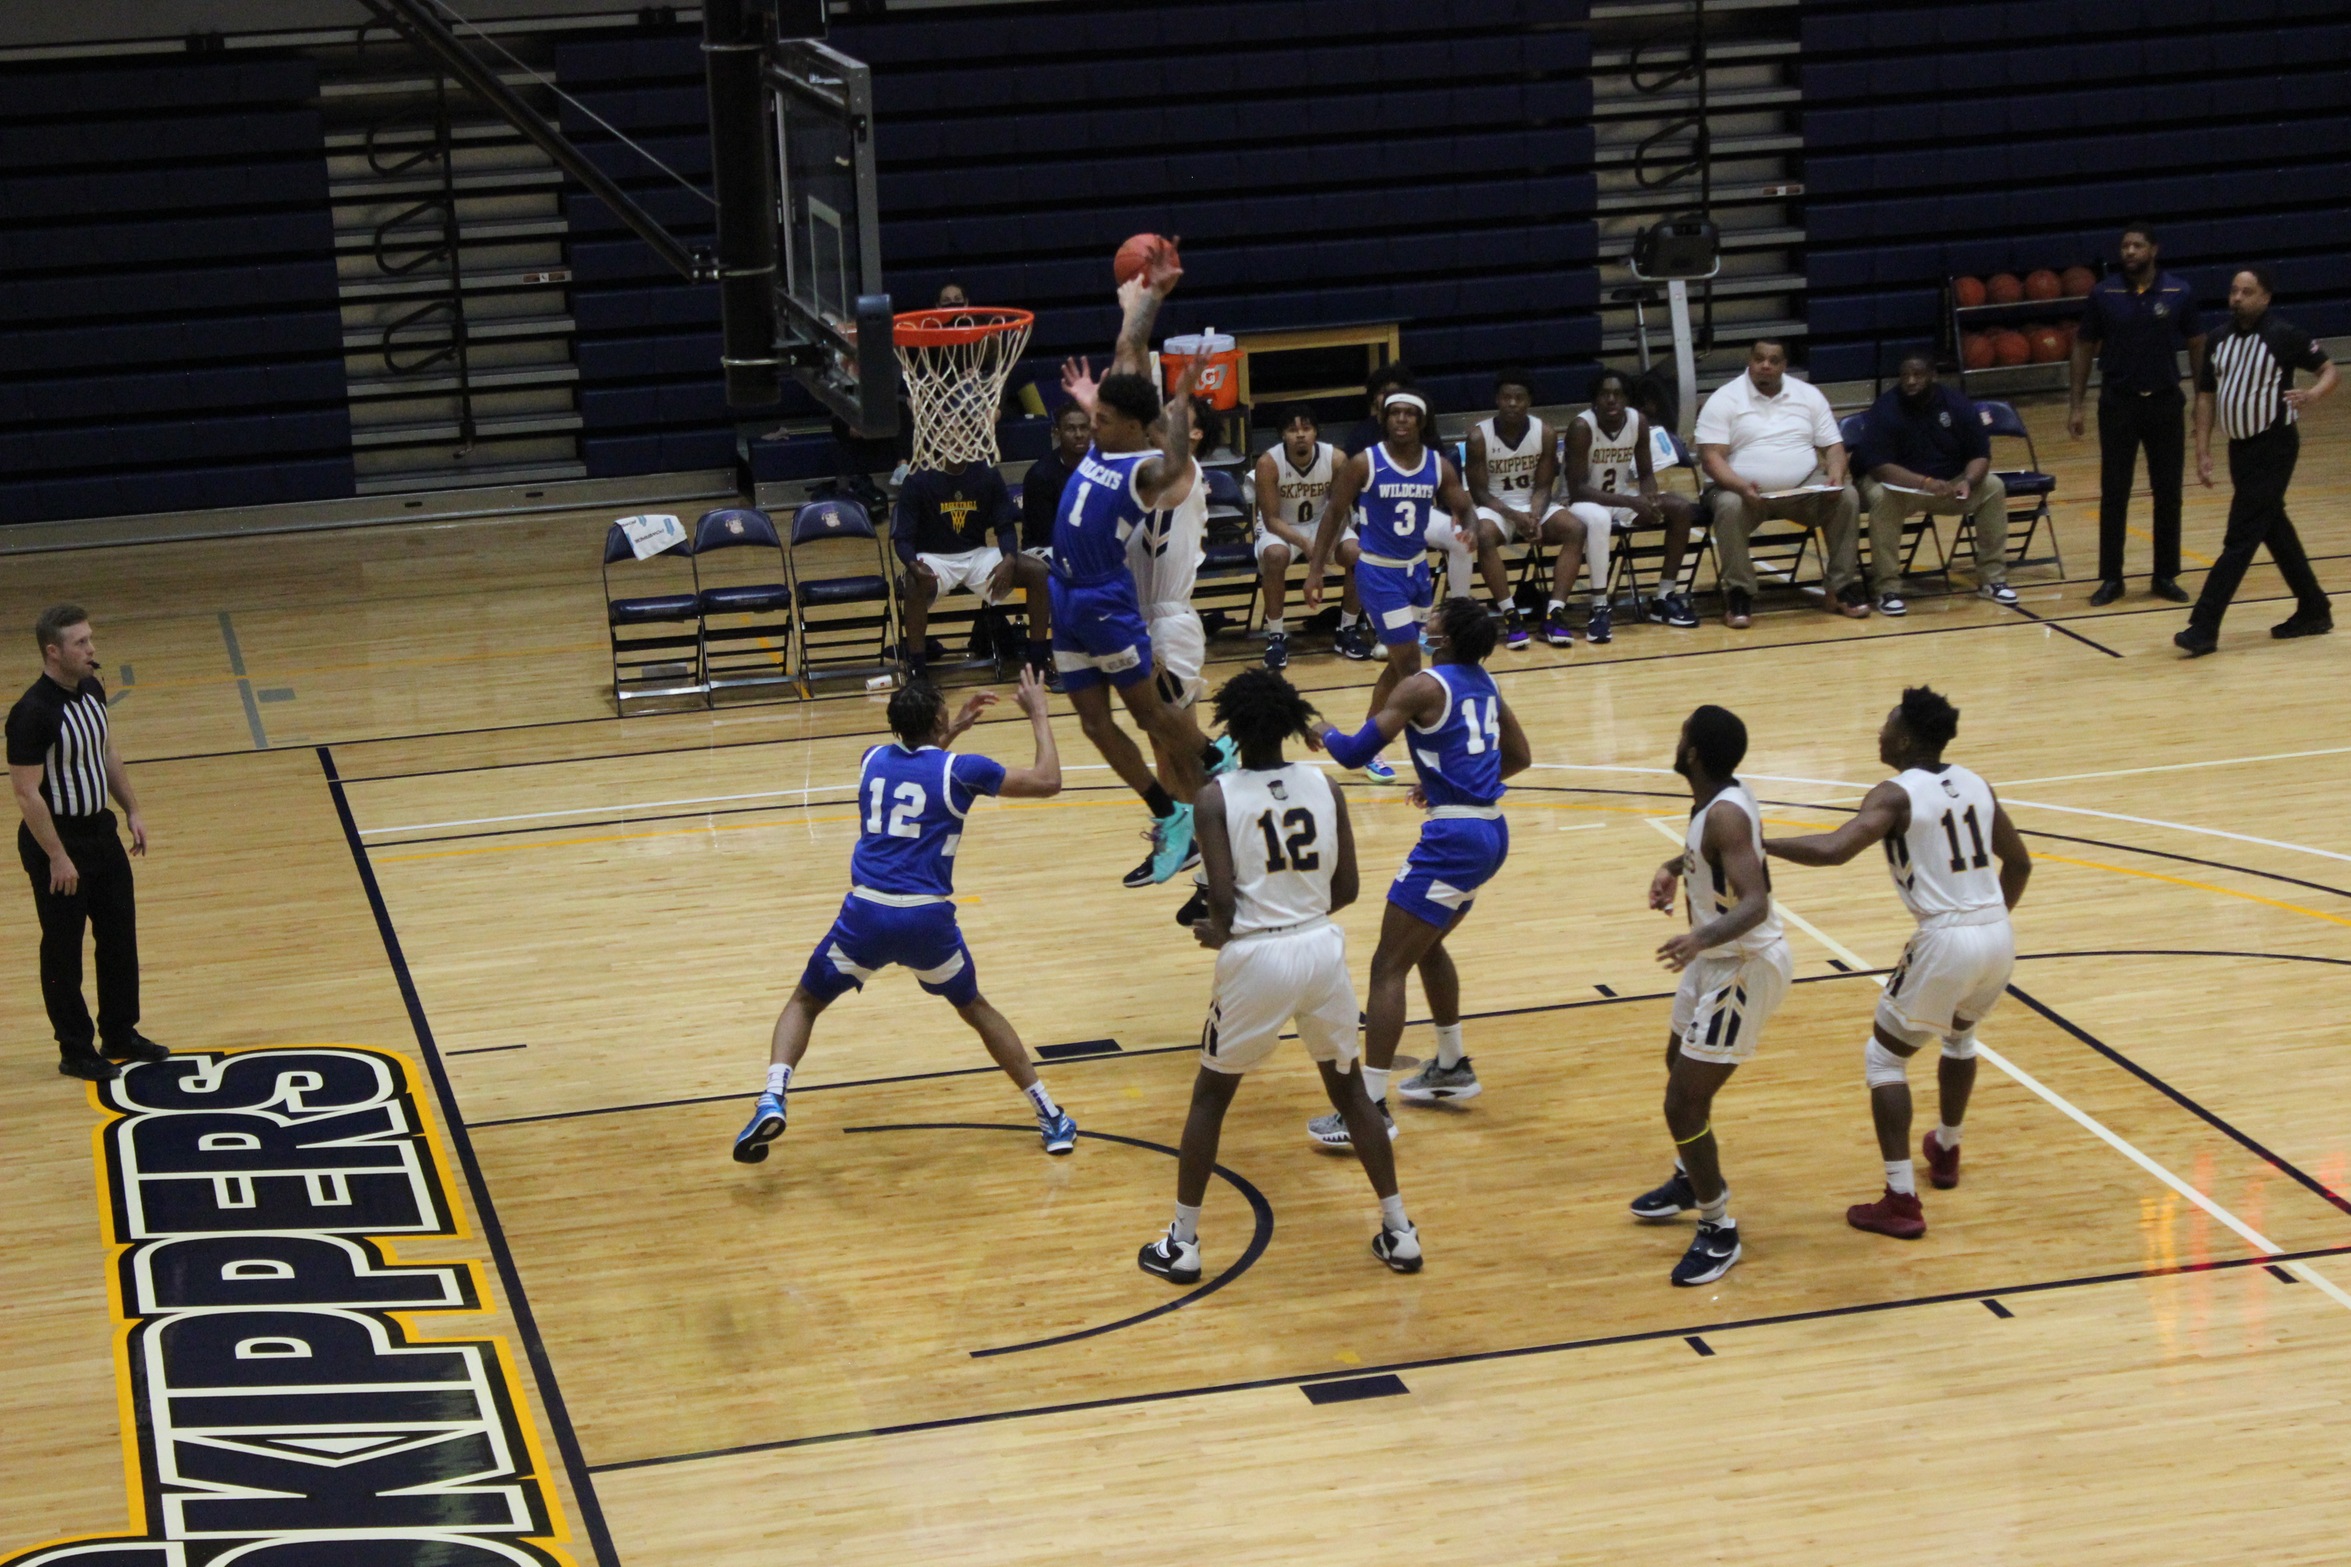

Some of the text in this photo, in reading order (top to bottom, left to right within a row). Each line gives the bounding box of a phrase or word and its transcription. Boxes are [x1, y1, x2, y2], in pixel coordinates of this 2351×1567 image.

[1592, 446, 1633, 464] SIPPERS
[1378, 483, 1434, 499] WILDCATS
[1601, 468, 1617, 493] 2
[1068, 481, 1092, 528] 1
[1298, 500, 1314, 522] 0
[1393, 500, 1416, 537] 3
[1461, 695, 1501, 755] 14
[866, 777, 927, 839] 12
[1257, 807, 1319, 874] 12
[1940, 804, 1990, 874] 11
[8, 1048, 550, 1567] KIPPERS
